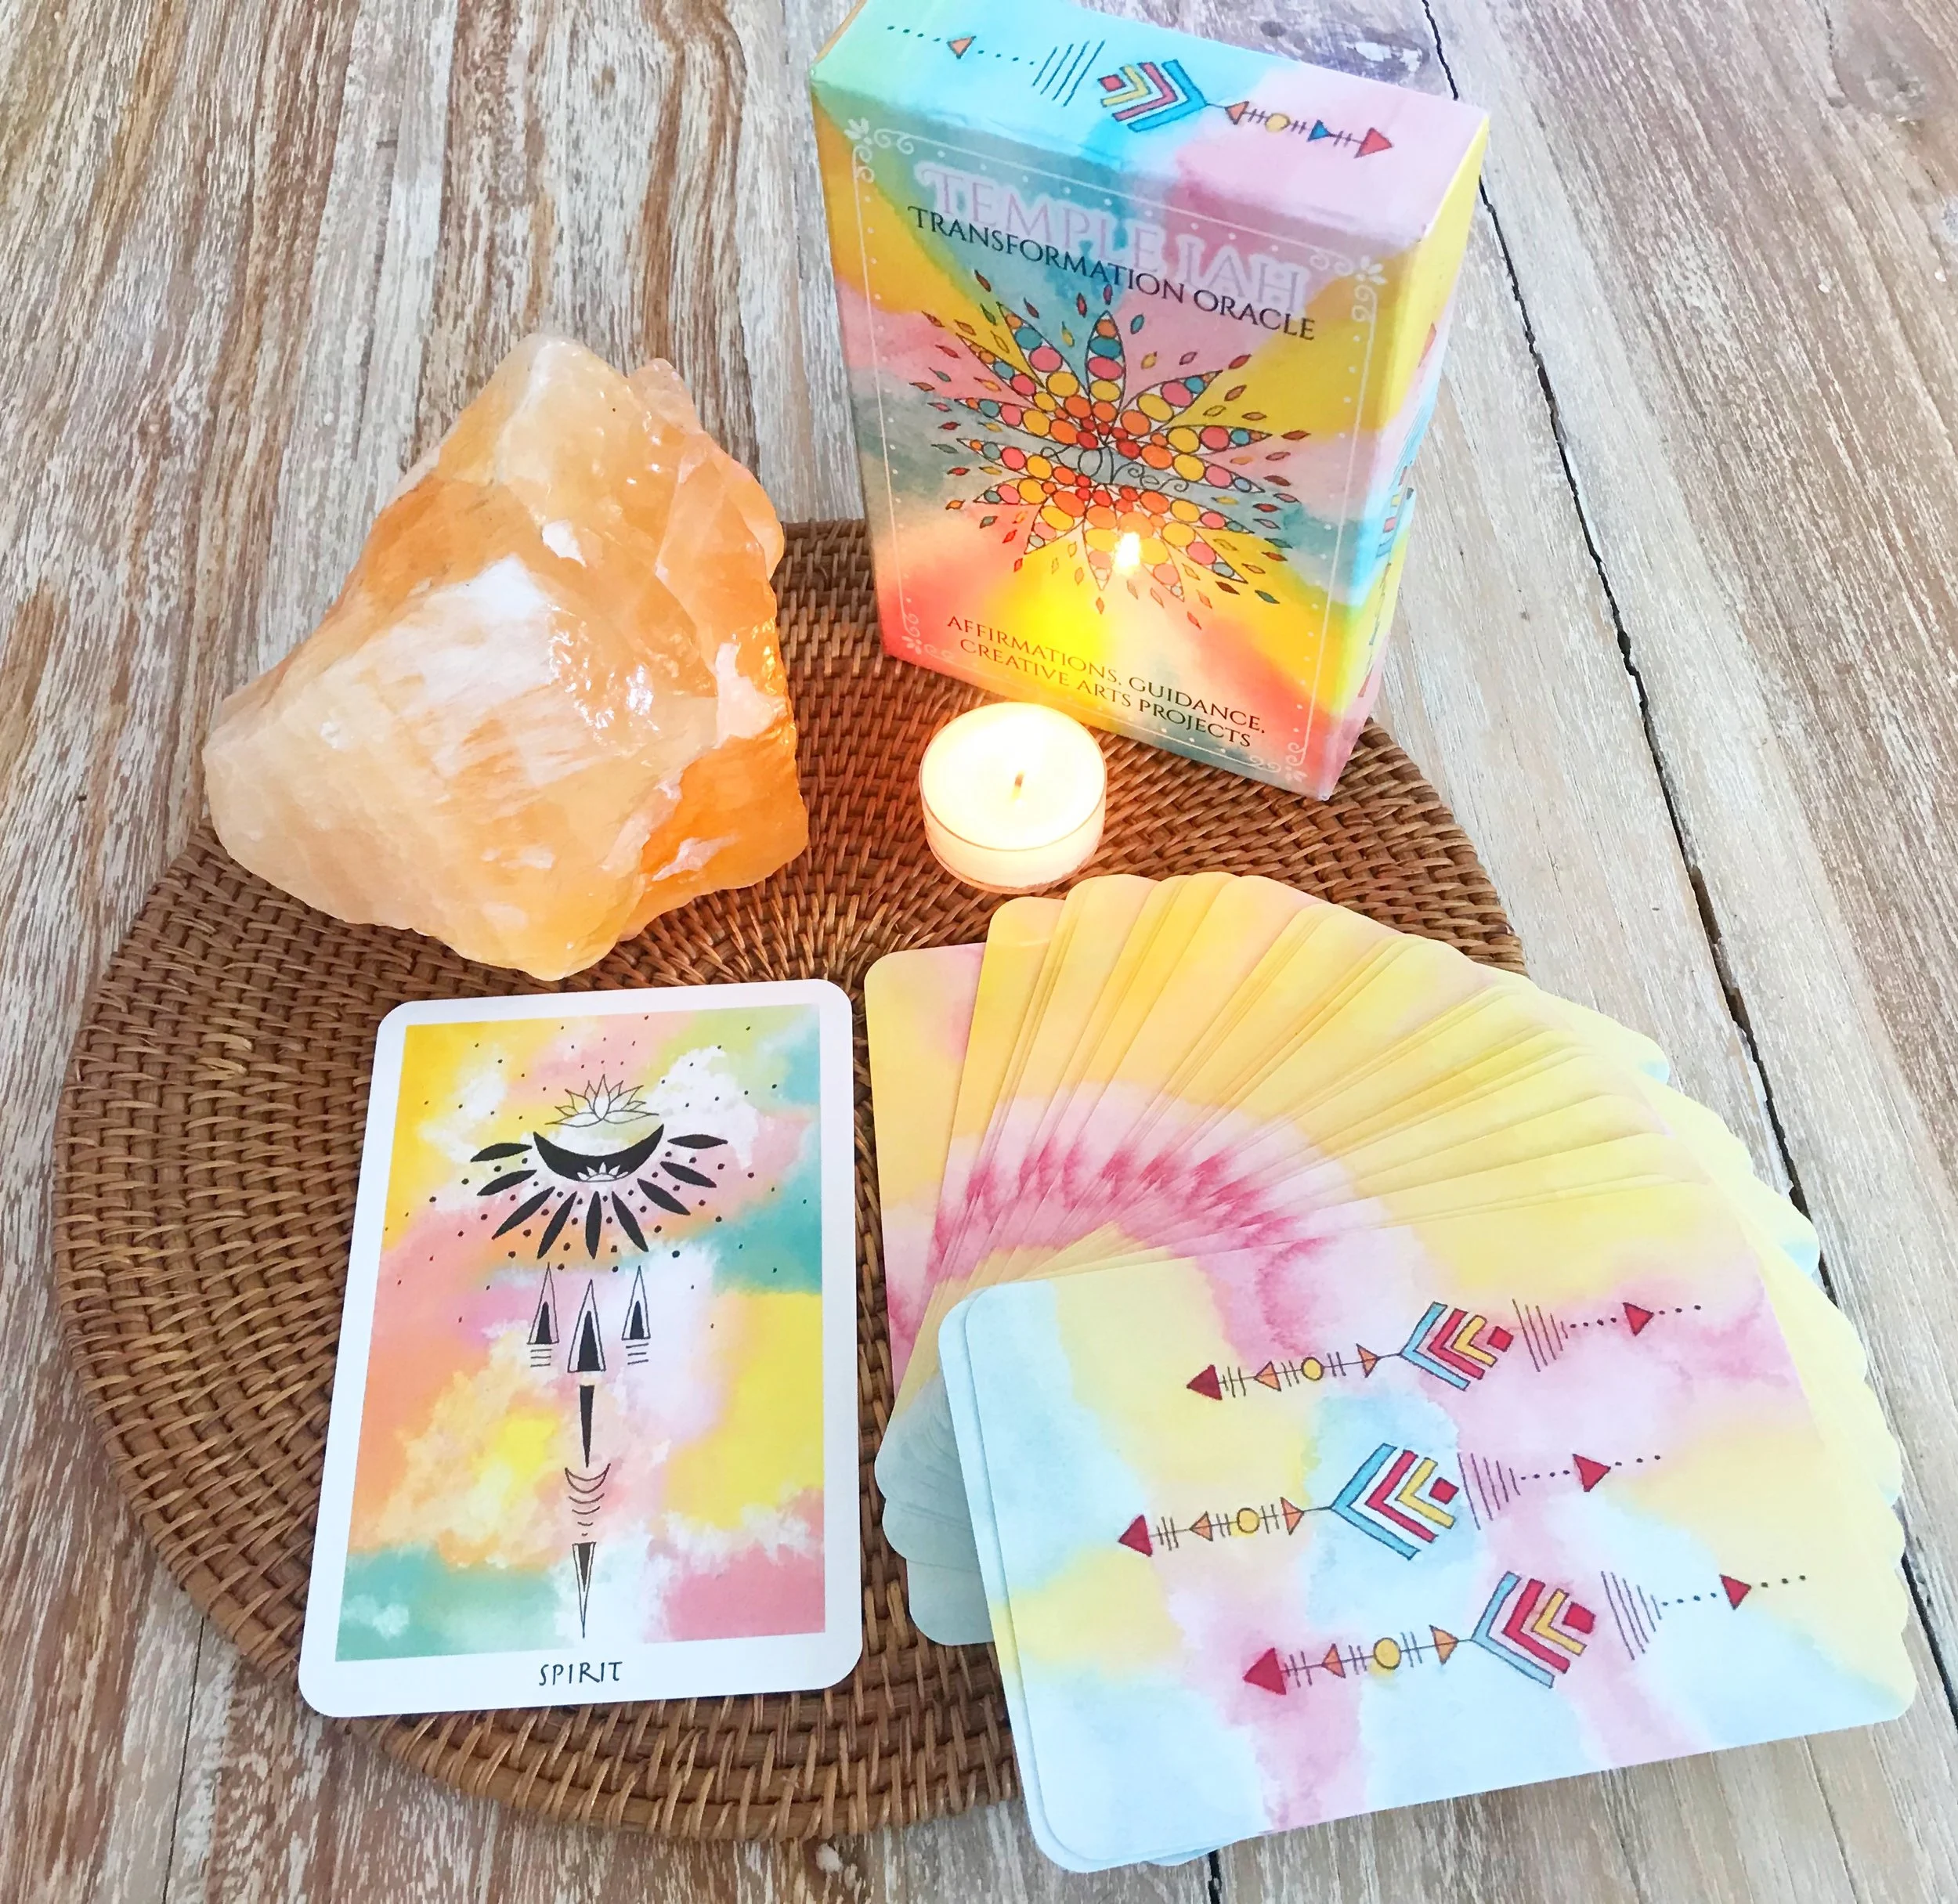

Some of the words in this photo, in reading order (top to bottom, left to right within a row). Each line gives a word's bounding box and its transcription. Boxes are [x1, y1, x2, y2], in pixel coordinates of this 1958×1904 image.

[908, 205, 1184, 304] TRANSFORMATION
[1193, 289, 1316, 341] ORACLE
[916, 163, 1165, 276] TEMPLE
[960, 639, 1070, 687] CREATIVE
[1076, 679, 1132, 708] ARTS
[1138, 698, 1251, 748] PROJECTS
[538, 1660, 623, 1686] SPIRIT
